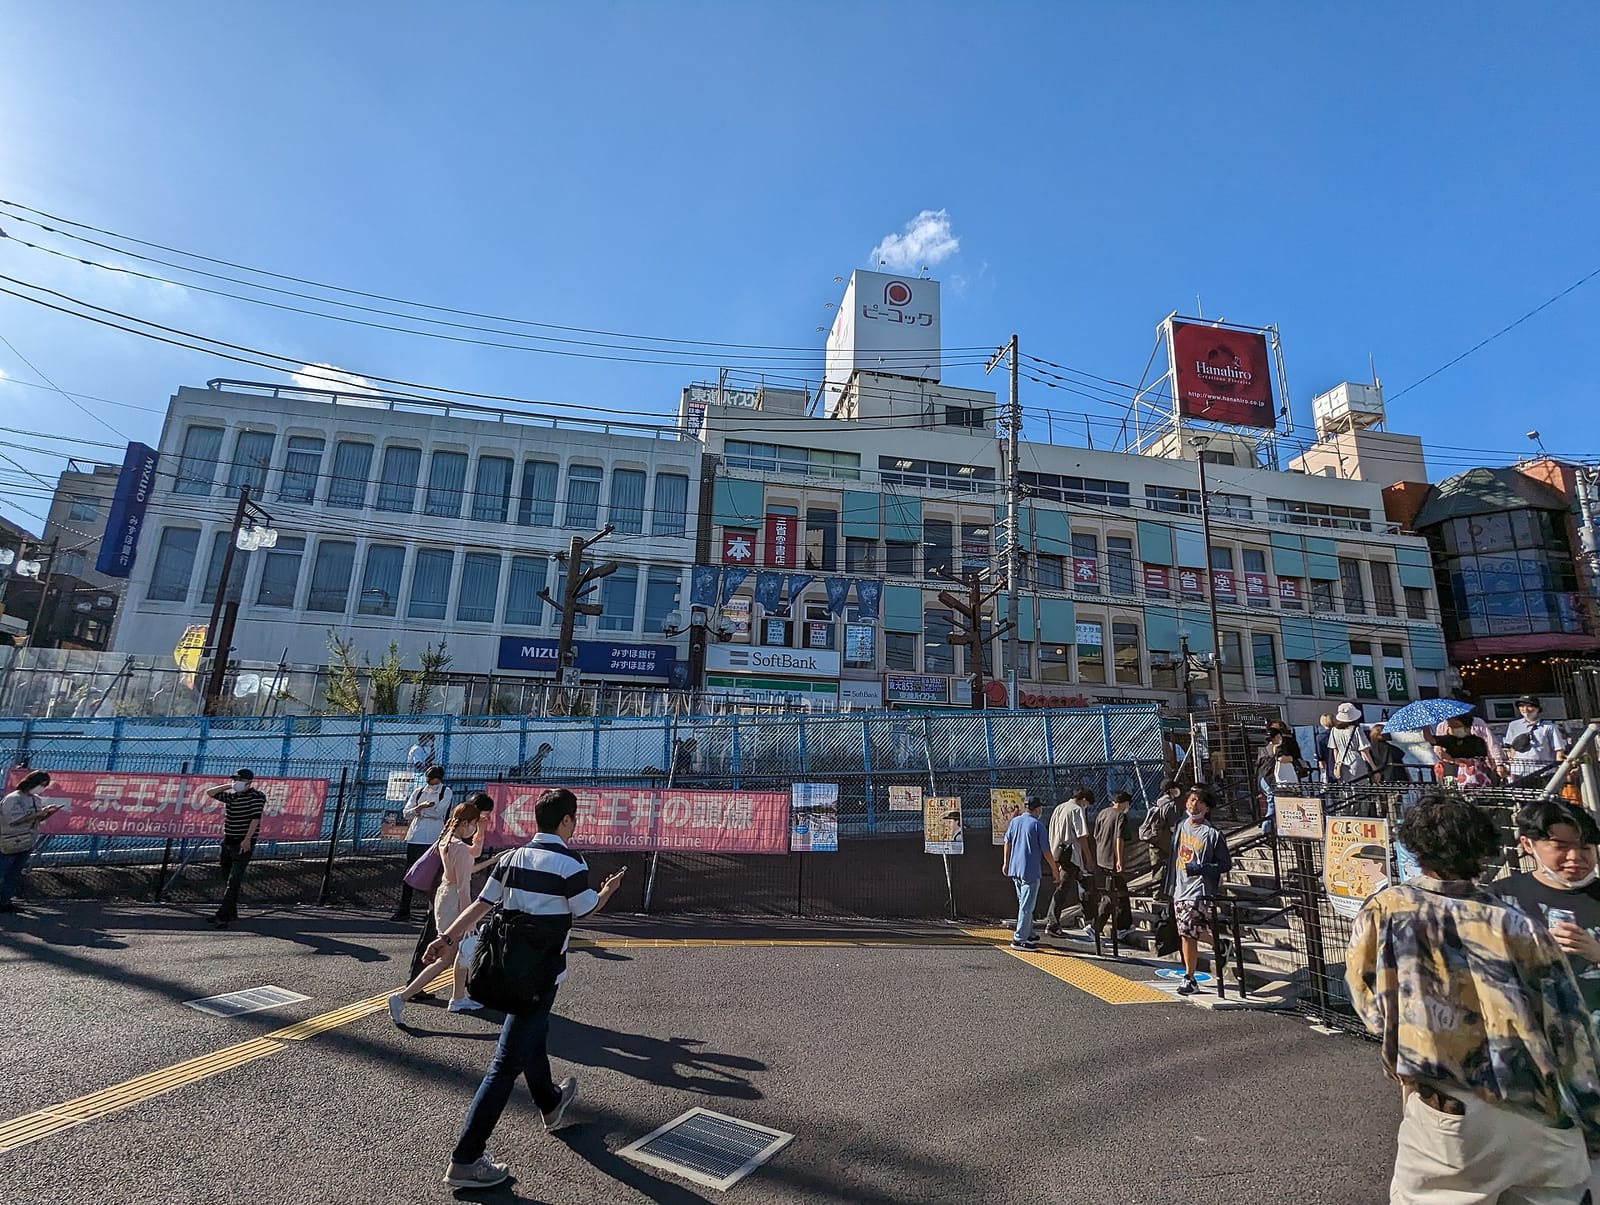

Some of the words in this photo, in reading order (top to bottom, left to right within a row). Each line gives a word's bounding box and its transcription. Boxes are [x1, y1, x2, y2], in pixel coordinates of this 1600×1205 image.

[863, 304, 932, 327] ピーコック
[1196, 361, 1252, 380] Hanahiro
[1188, 391, 1265, 407] http://www.hanahiro.co.jp
[136, 456, 154, 503] MIZUHO
[726, 536, 751, 561] 本
[775, 516, 787, 566] 三省堂書店
[1077, 561, 1094, 580] 本
[1147, 568, 1296, 597] 三省堂書店
[521, 646, 559, 659] MIZU
[611, 648, 656, 660] みずほ銀行
[752, 651, 817, 670] SoftBank
[610, 660, 656, 671] みずほ証券
[1322, 667, 1404, 692] 清龍苑
[852, 690, 878, 698] SoftBank
[90, 776, 288, 817] 京王井の線
[576, 791, 754, 830] 京王井の頭線
[87, 817, 118, 832] Keio
[122, 817, 195, 834] Inokashira
[1331, 821, 1377, 838] CZECH
[569, 832, 597, 845] Keio
[601, 834, 671, 847] Inokashira
[674, 834, 701, 848] Line
